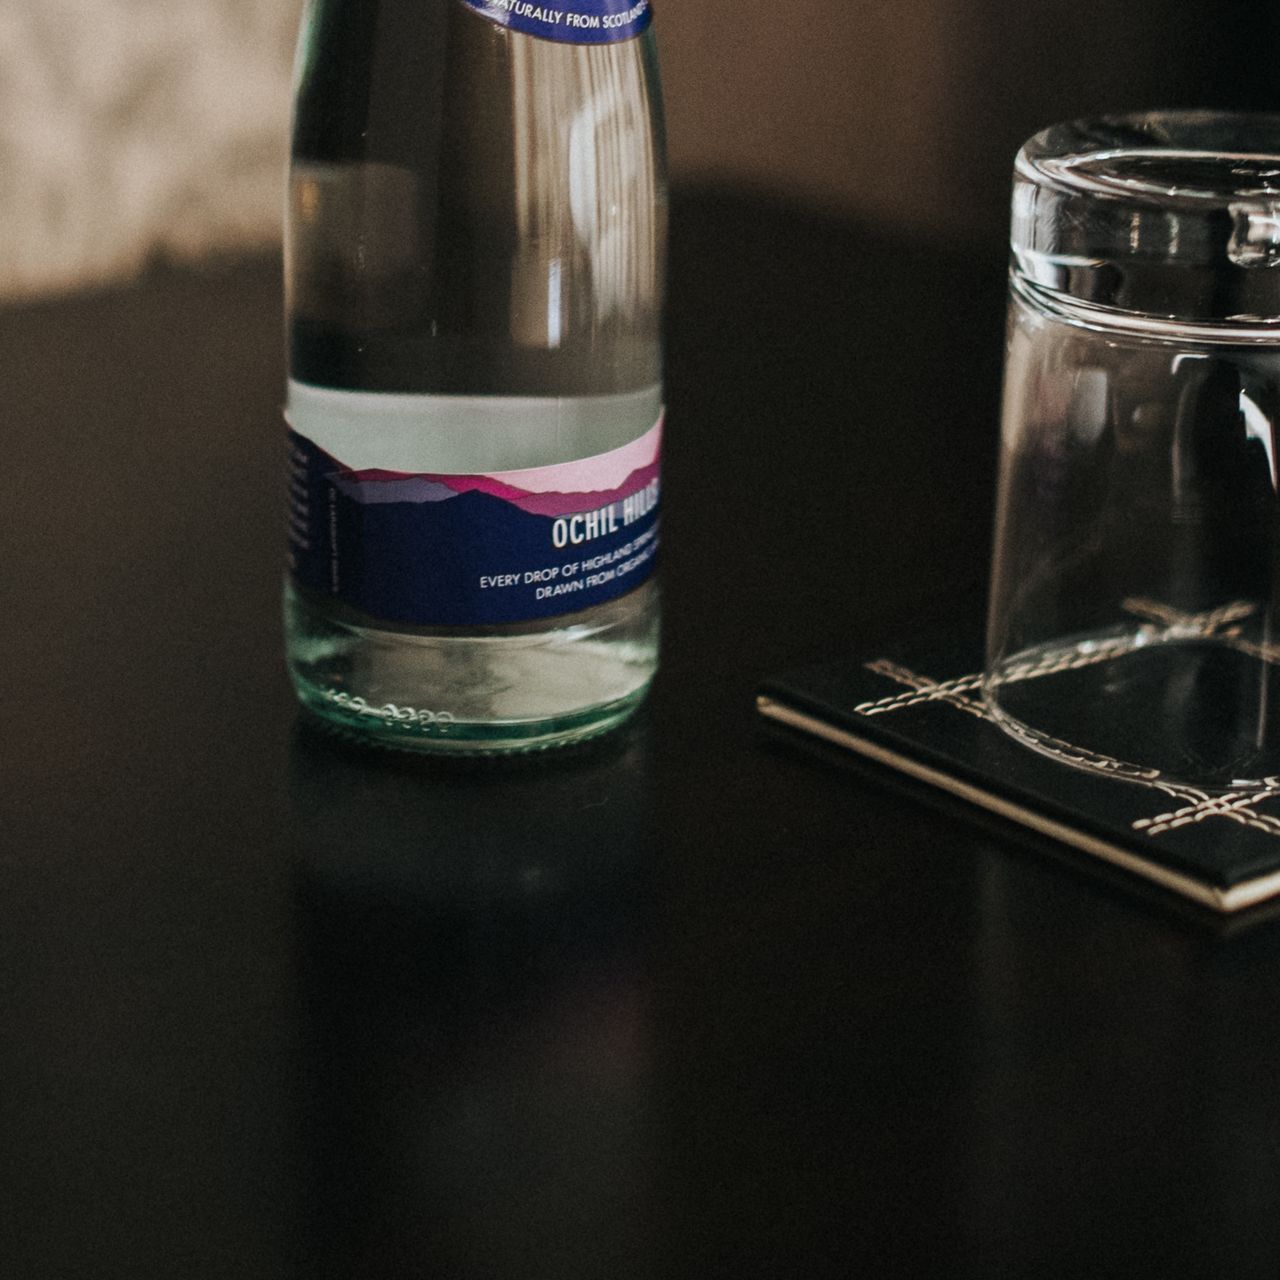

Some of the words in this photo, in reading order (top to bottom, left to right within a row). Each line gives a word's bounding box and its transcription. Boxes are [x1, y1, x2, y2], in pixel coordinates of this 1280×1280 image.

[566, 14, 600, 29] FROM
[552, 504, 619, 549] OCHIL
[479, 573, 521, 589] EVERY
[524, 567, 559, 584] DROP
[561, 561, 579, 577] OF
[581, 543, 632, 571] HIGHLAND
[535, 579, 584, 600] DRAWN
[586, 569, 615, 588] FROM
